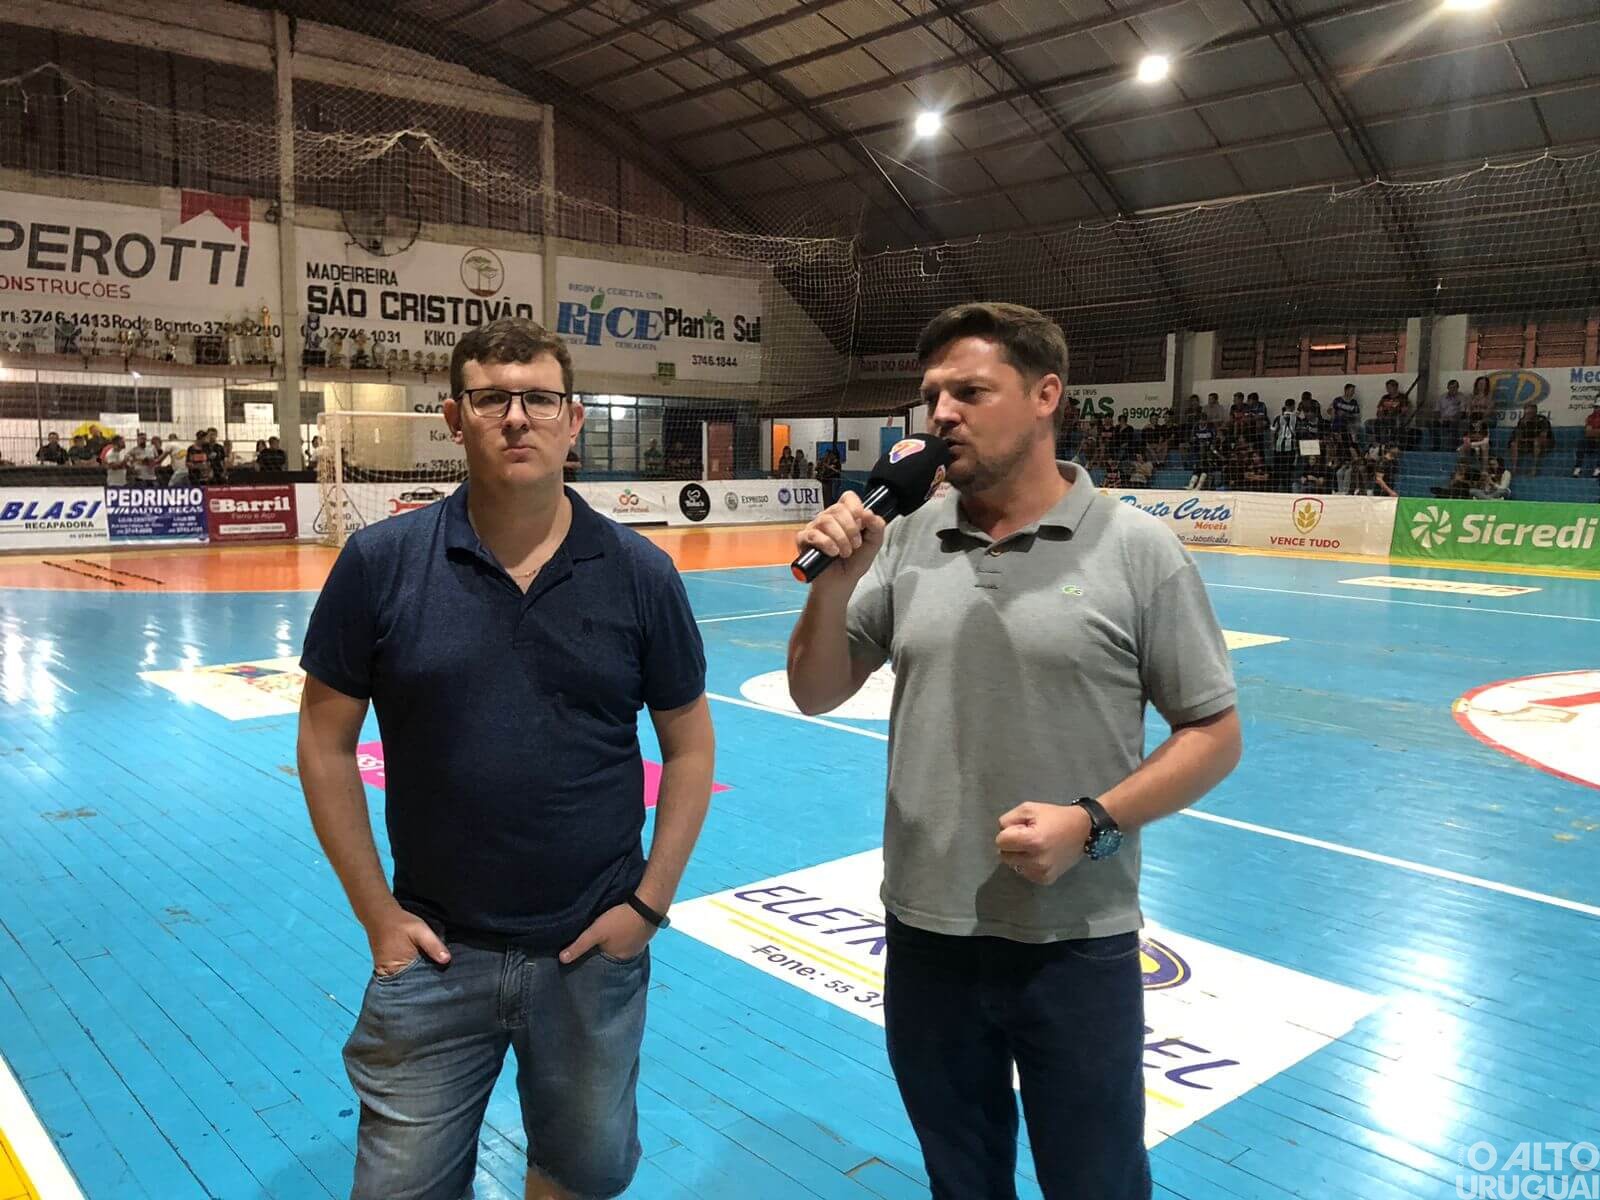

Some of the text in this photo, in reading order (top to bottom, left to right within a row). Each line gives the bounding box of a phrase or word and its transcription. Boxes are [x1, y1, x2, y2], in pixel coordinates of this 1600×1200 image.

[0, 220, 249, 287] PEROTTI
[306, 262, 398, 287] MADEIREIRA
[307, 282, 533, 327] SÃO CRISTOVÃO
[664, 307, 761, 343] Planta Sul
[425, 331, 455, 346] KIKO
[107, 489, 203, 507] PEDRINHO
[221, 497, 291, 513] Barril
[794, 488, 819, 504] URI
[0, 500, 101, 521] BLASI
[1173, 497, 1232, 521] Certo
[25, 521, 94, 529] RECAPADORA
[1194, 521, 1227, 530] Móveis
[1457, 514, 1598, 549] Sicredi
[1270, 536, 1341, 549] VENCE TUDO
[824, 980, 855, 994] 55
